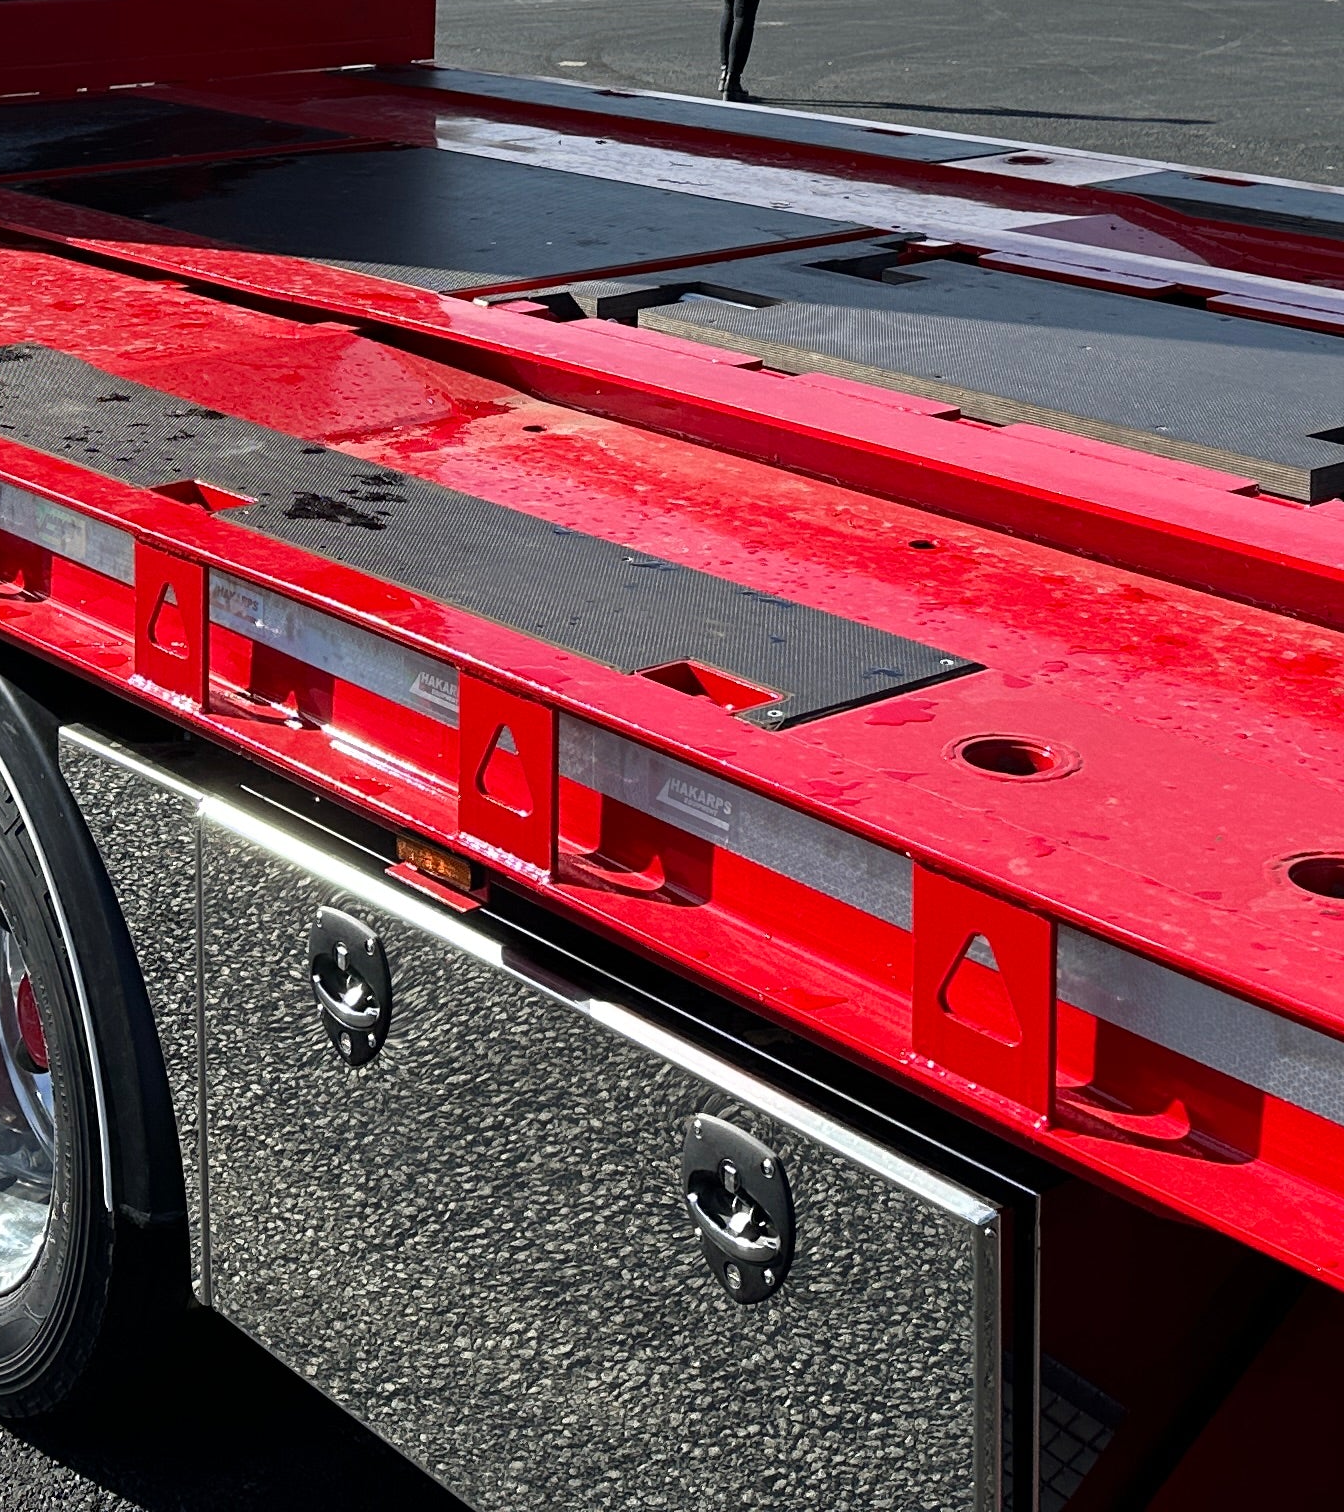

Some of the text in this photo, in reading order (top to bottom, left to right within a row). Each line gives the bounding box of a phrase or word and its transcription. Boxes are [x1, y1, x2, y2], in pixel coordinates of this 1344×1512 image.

[214, 583, 260, 613] HAKRPS
[420, 672, 458, 698] HAKAR
[670, 777, 733, 816] HAKARPS
